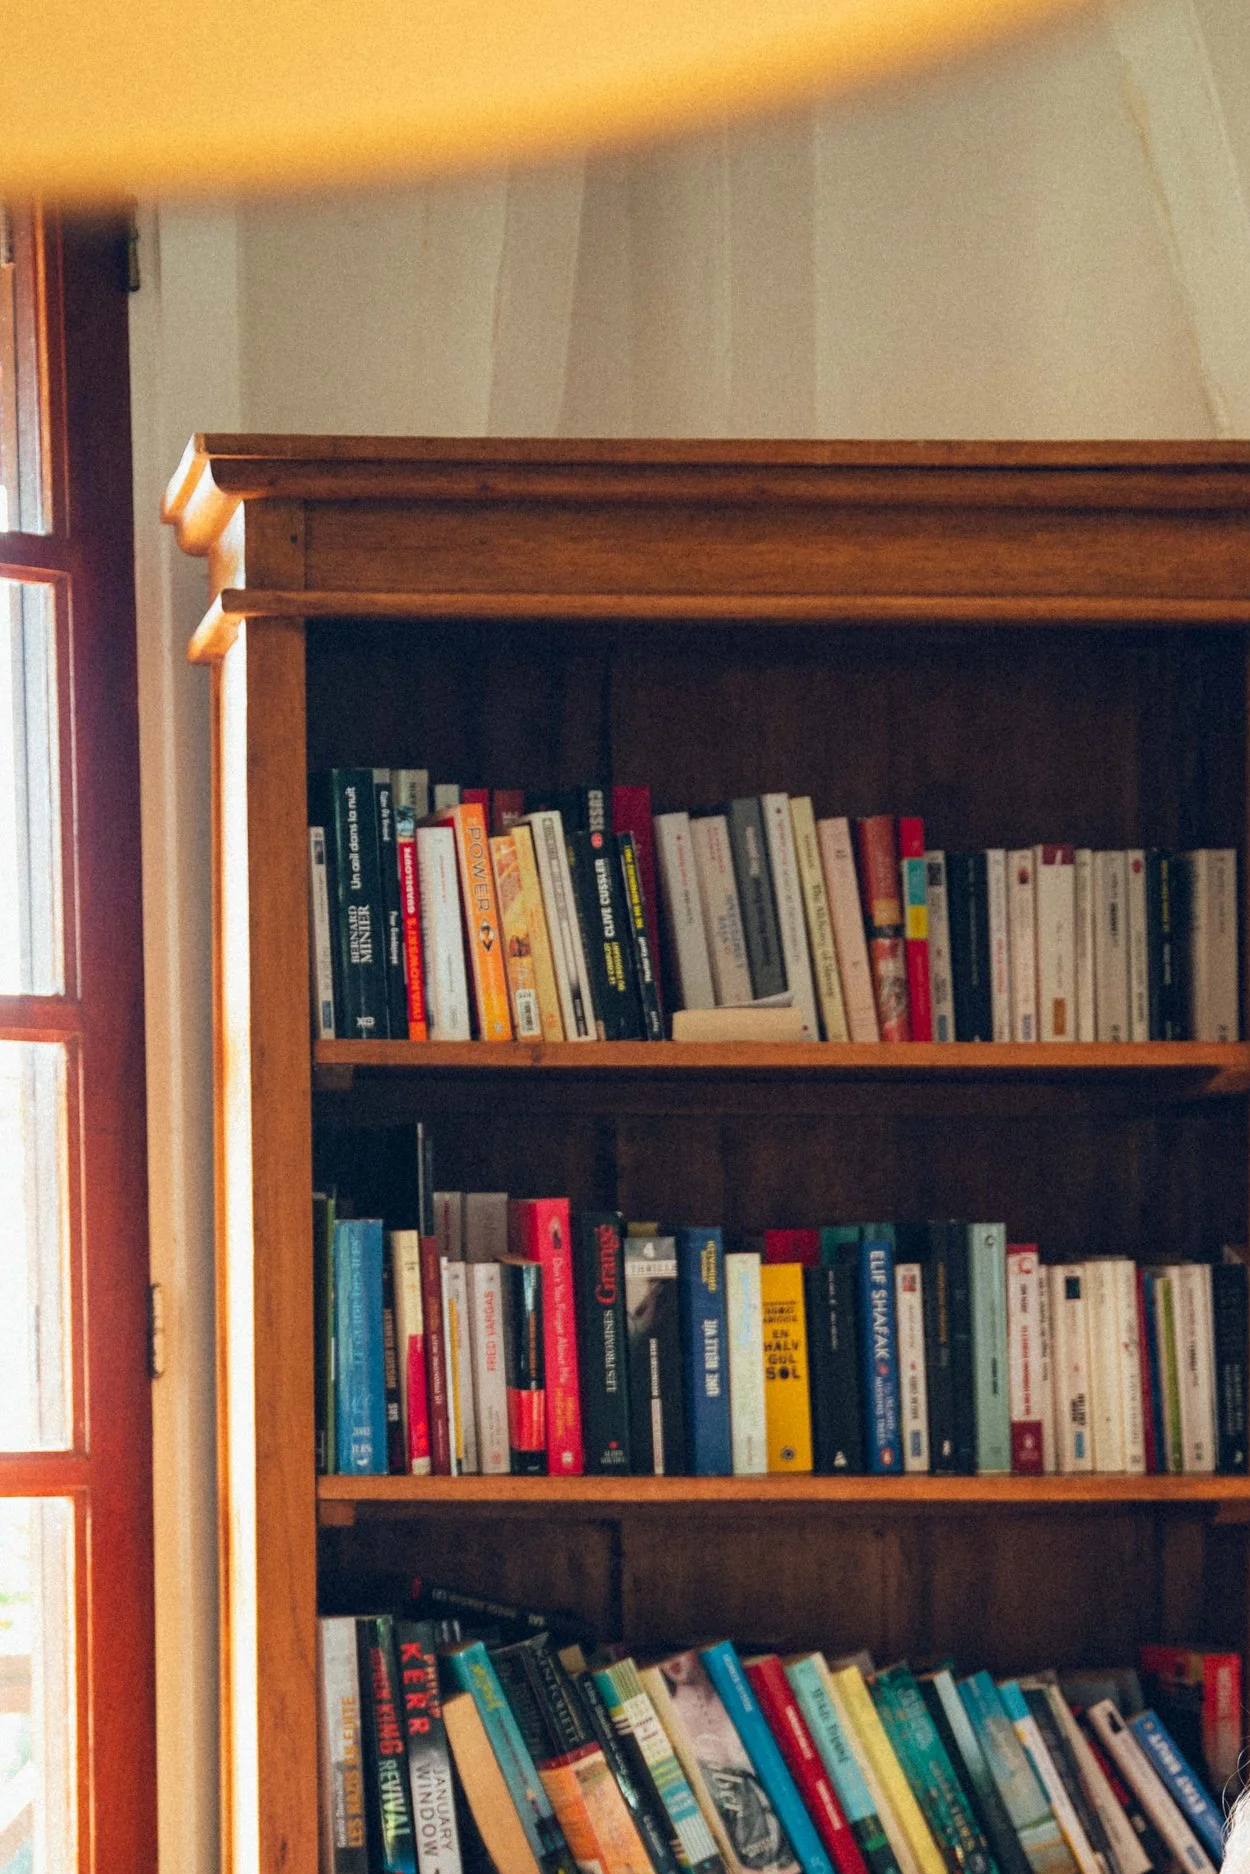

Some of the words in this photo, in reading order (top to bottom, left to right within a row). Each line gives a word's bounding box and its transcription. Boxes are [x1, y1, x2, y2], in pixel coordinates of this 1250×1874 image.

[346, 786, 357, 810] nuit
[348, 811, 358, 822] la
[348, 824, 360, 851] dans
[350, 873, 361, 889] Un
[466, 827, 490, 912] POWER
[595, 858, 610, 904] CUSSLER
[348, 905, 360, 964] BERNARD
[358, 904, 372, 964] MINIER
[601, 906, 615, 938] CLIVE
[594, 1224, 619, 1305] Grangé
[869, 1250, 888, 1286] ELIF
[484, 1290, 496, 1336] VARGAS
[702, 1318, 717, 1336] VIE
[871, 1290, 890, 1362] SHAFAK
[486, 1341, 498, 1372] FRED
[604, 1309, 616, 1369] PROMISES
[704, 1338, 720, 1370] BELLE
[764, 1340, 798, 1352] HALV
[605, 1370, 617, 1393] LES
[705, 1373, 720, 1398] UNE
[766, 1366, 800, 1380] SOL
[400, 1641, 430, 1736] KERR
[423, 1653, 441, 1718] PHILIP
[376, 1703, 404, 1755] KING
[344, 1770, 362, 1817] NAZIS
[378, 1758, 411, 1837] REVIVAL
[415, 1762, 439, 1857] WINDOW
[432, 1762, 454, 1854] JANUARY
[346, 1819, 364, 1848] LES
